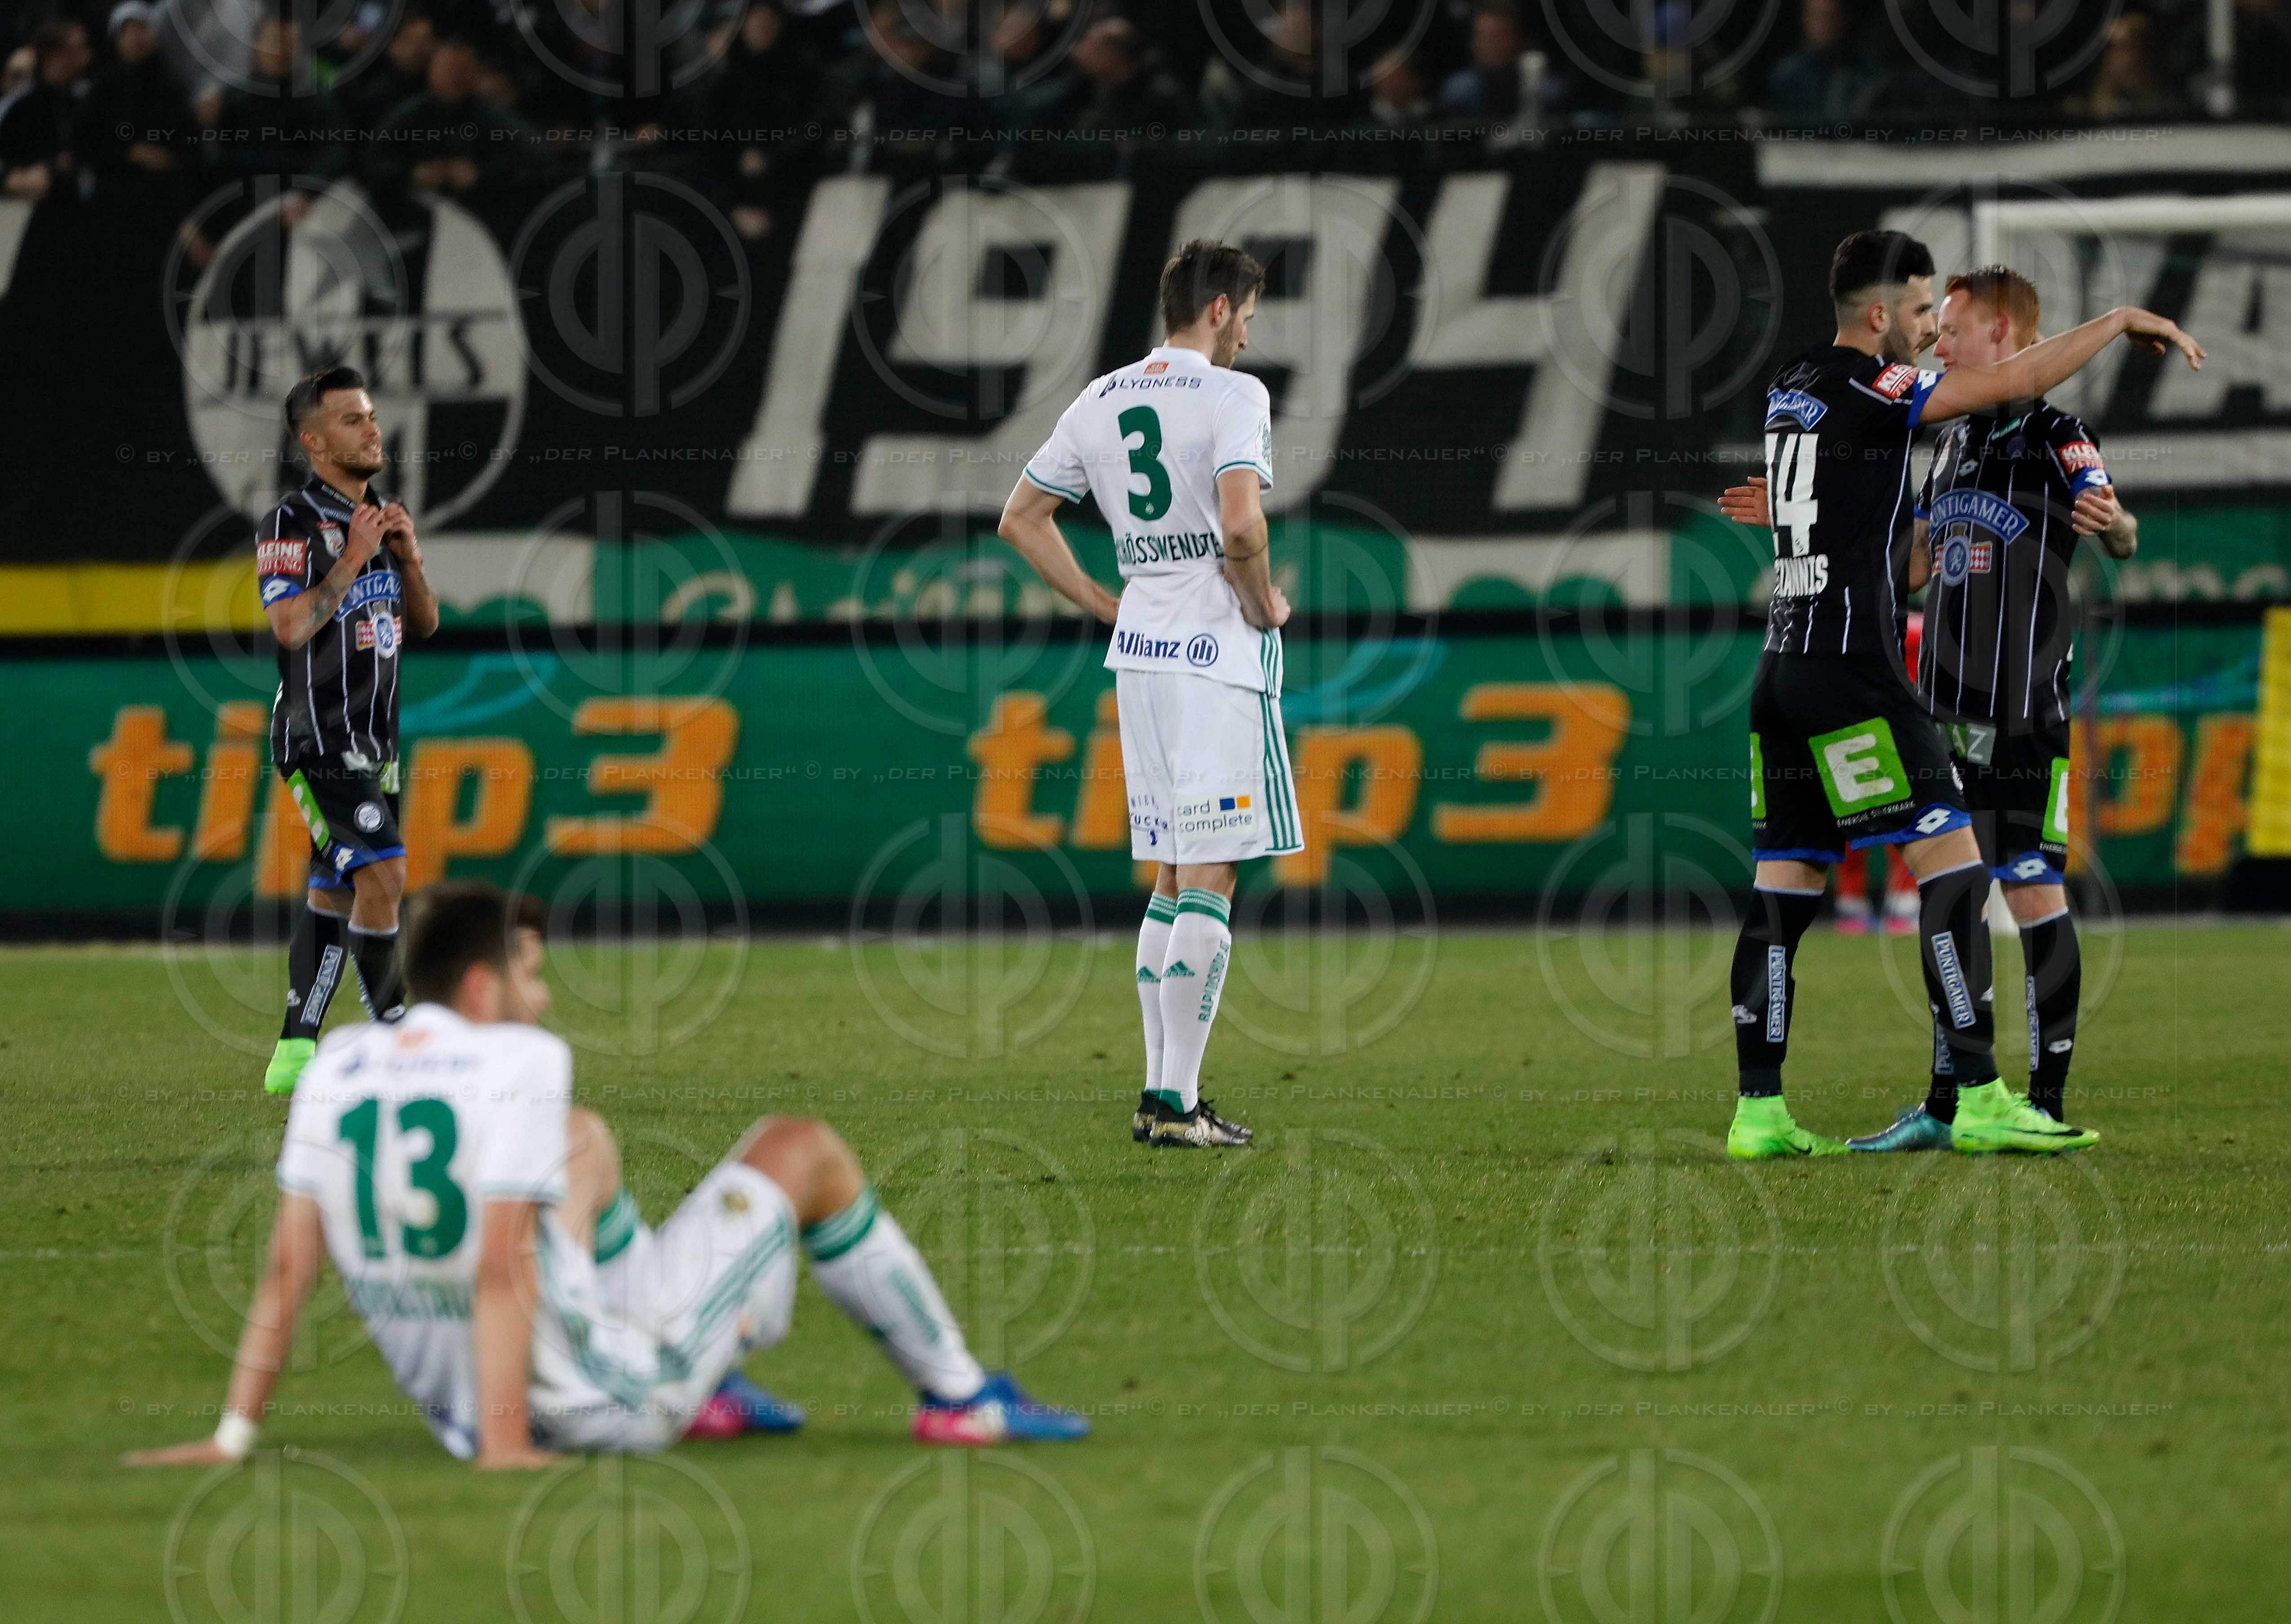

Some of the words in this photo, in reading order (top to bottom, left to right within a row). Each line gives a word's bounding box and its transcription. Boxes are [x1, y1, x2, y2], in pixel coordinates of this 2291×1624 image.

[724, 161, 1667, 518] 1994
[1119, 376, 1202, 389] LYONESS
[1118, 405, 1172, 521] 3
[1765, 432, 1819, 557] 14
[1930, 493, 2020, 536] UNTIGAMER
[1117, 631, 1181, 658] Allianz
[1824, 734, 1894, 803] E
[1177, 799, 1211, 817] card
[1179, 813, 1252, 833] complete
[1936, 937, 1973, 1023] PUNTIGAMER
[338, 1097, 469, 1258] 13
